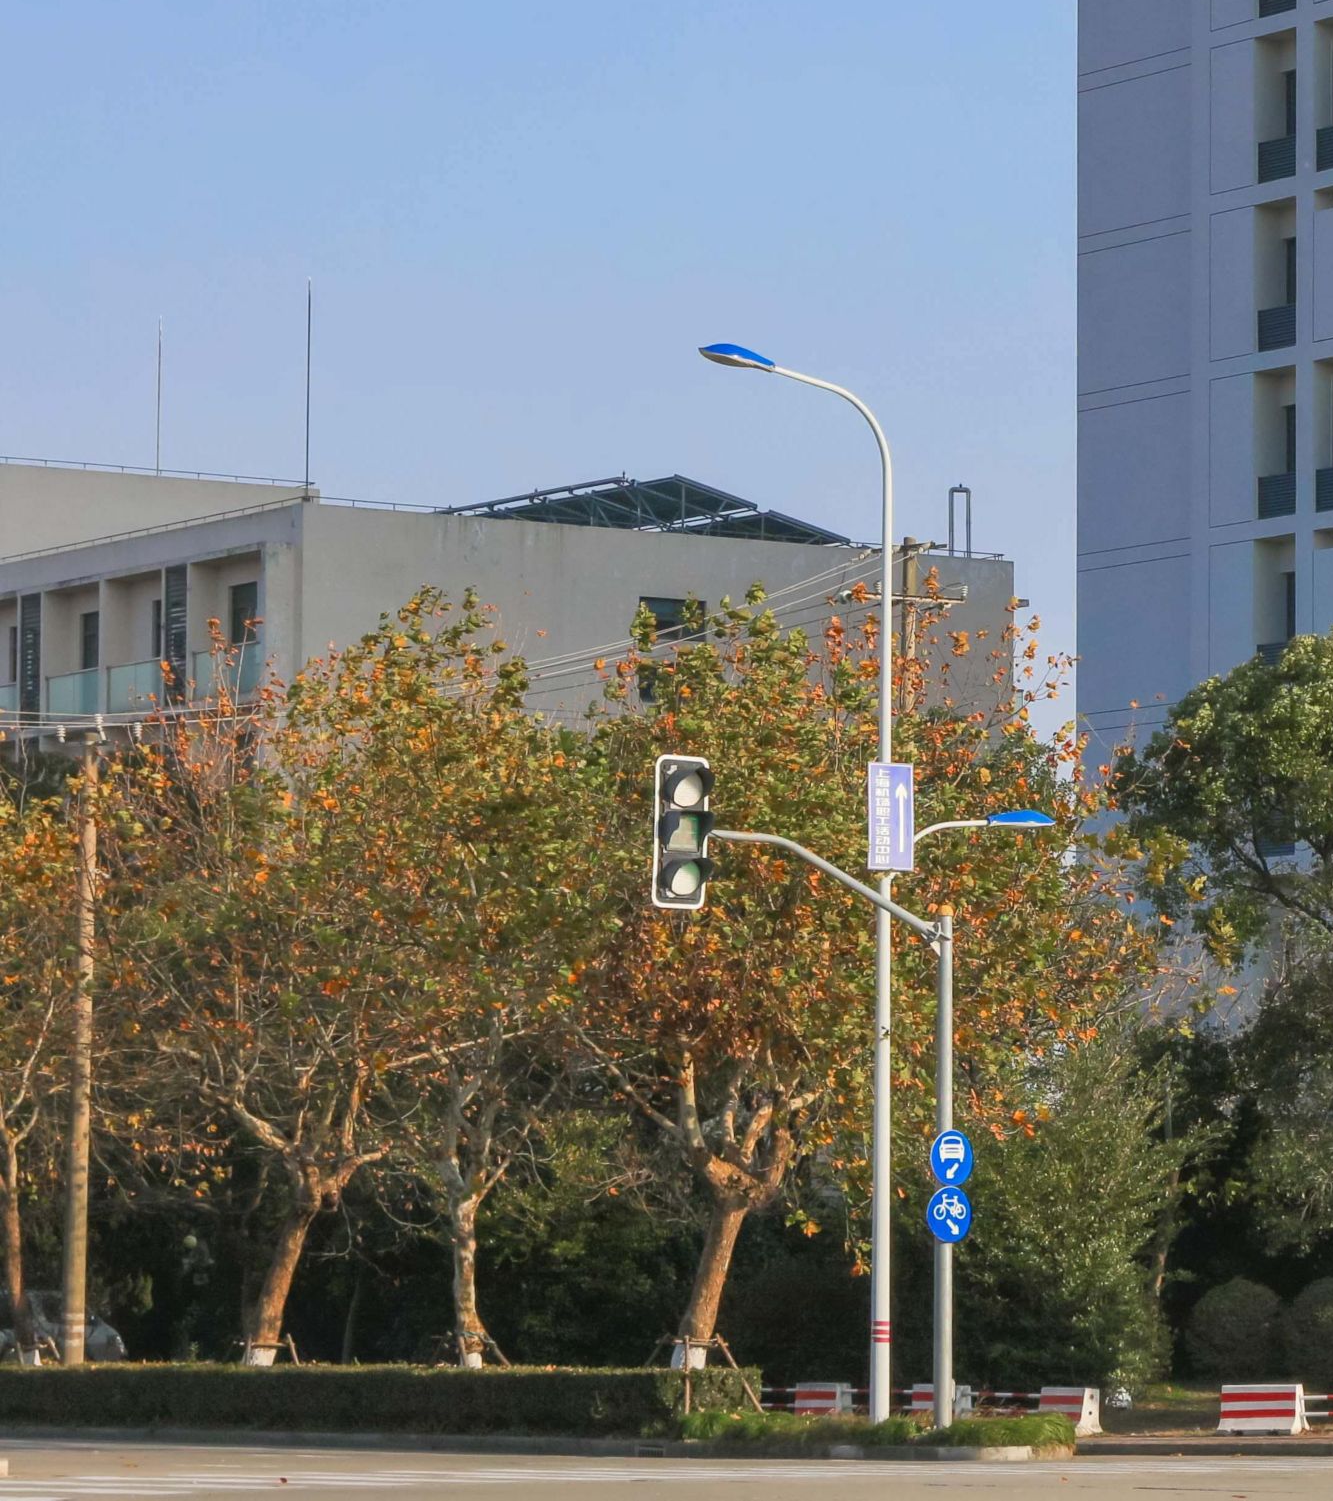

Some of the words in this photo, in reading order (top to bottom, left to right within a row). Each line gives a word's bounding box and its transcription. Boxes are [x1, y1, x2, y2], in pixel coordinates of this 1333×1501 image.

[875, 768, 890, 864] 上海机场职工活动中心
